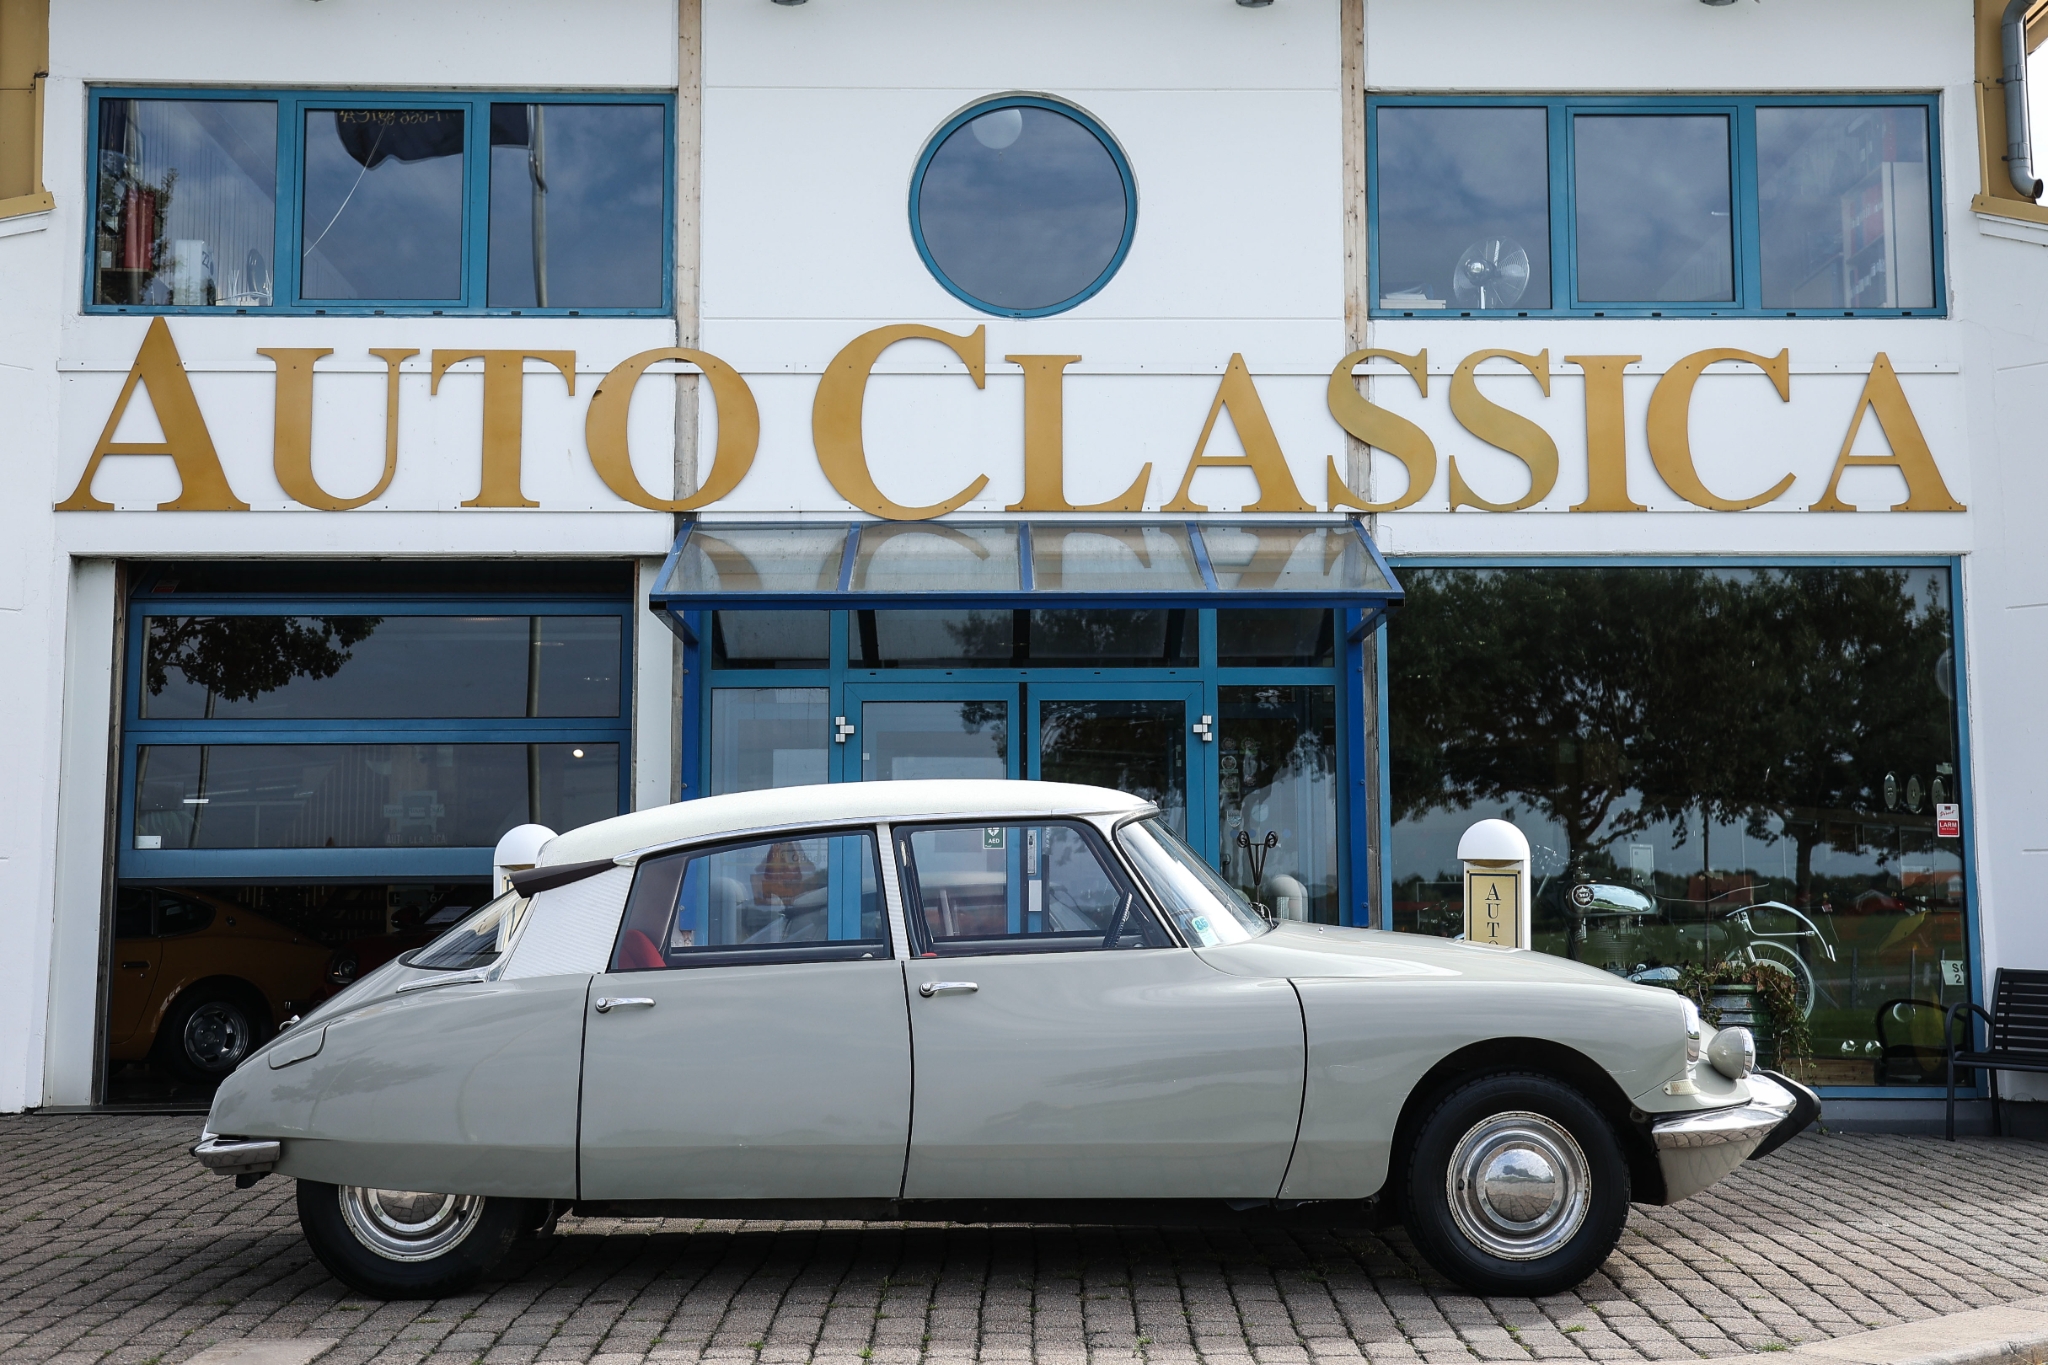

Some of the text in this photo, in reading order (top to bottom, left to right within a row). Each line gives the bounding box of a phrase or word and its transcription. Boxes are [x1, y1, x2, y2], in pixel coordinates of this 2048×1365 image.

[54, 315, 1967, 522] AUTO CLASSICA
[1484, 882, 1502, 945] AUT
[1954, 973, 1962, 984] 2
